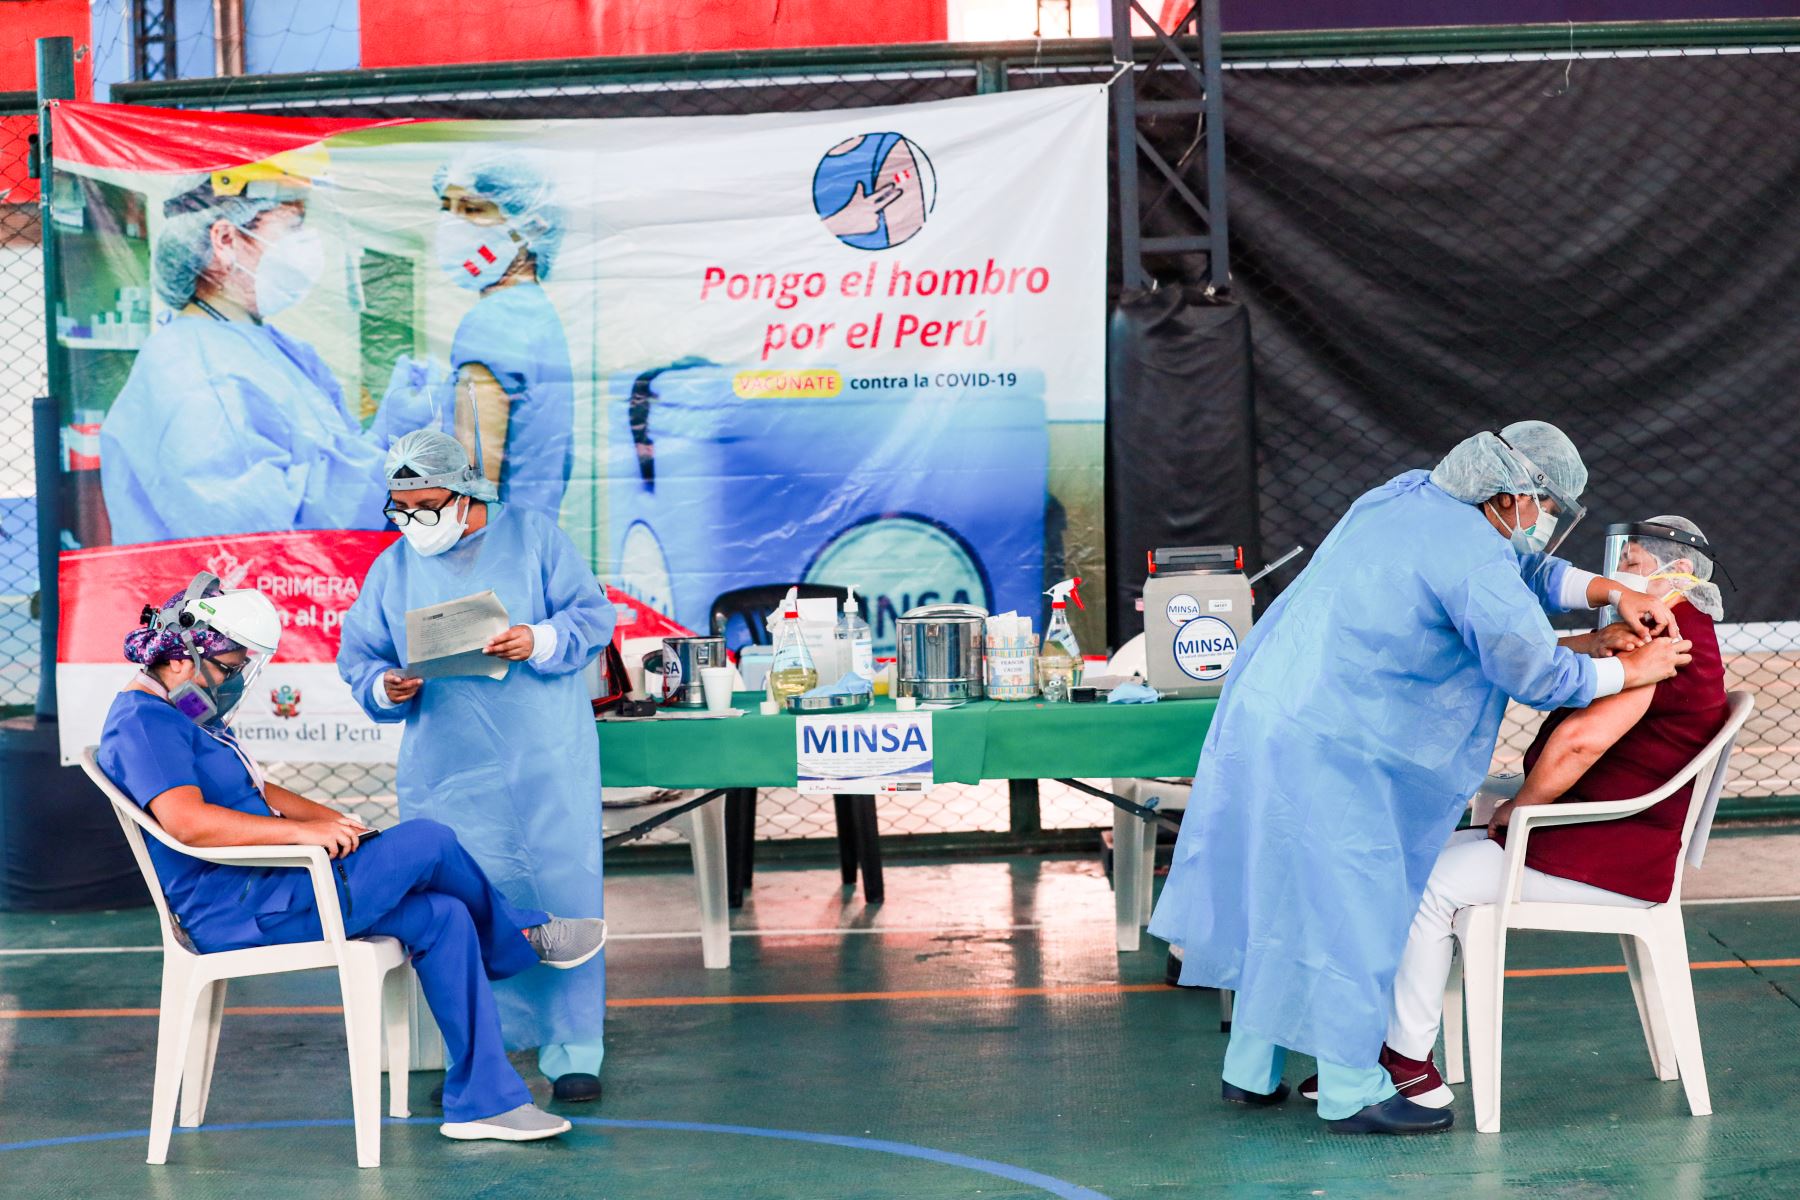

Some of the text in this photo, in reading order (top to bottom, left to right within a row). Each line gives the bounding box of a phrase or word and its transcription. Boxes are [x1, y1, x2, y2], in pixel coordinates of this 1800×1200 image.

[700, 258, 1051, 309] Pongo el hombro
[761, 309, 988, 360] por el Perú
[850, 373, 909, 389] contra
[914, 373, 929, 388] la
[935, 372, 1018, 388] COVID-19
[256, 576, 359, 598] PRIMERA
[295, 605, 317, 626] al
[1168, 605, 1199, 614] MINSA
[1178, 637, 1235, 655] MINSA
[234, 721, 289, 741] ierno
[296, 722, 326, 741] del
[803, 722, 928, 754] MINSA
